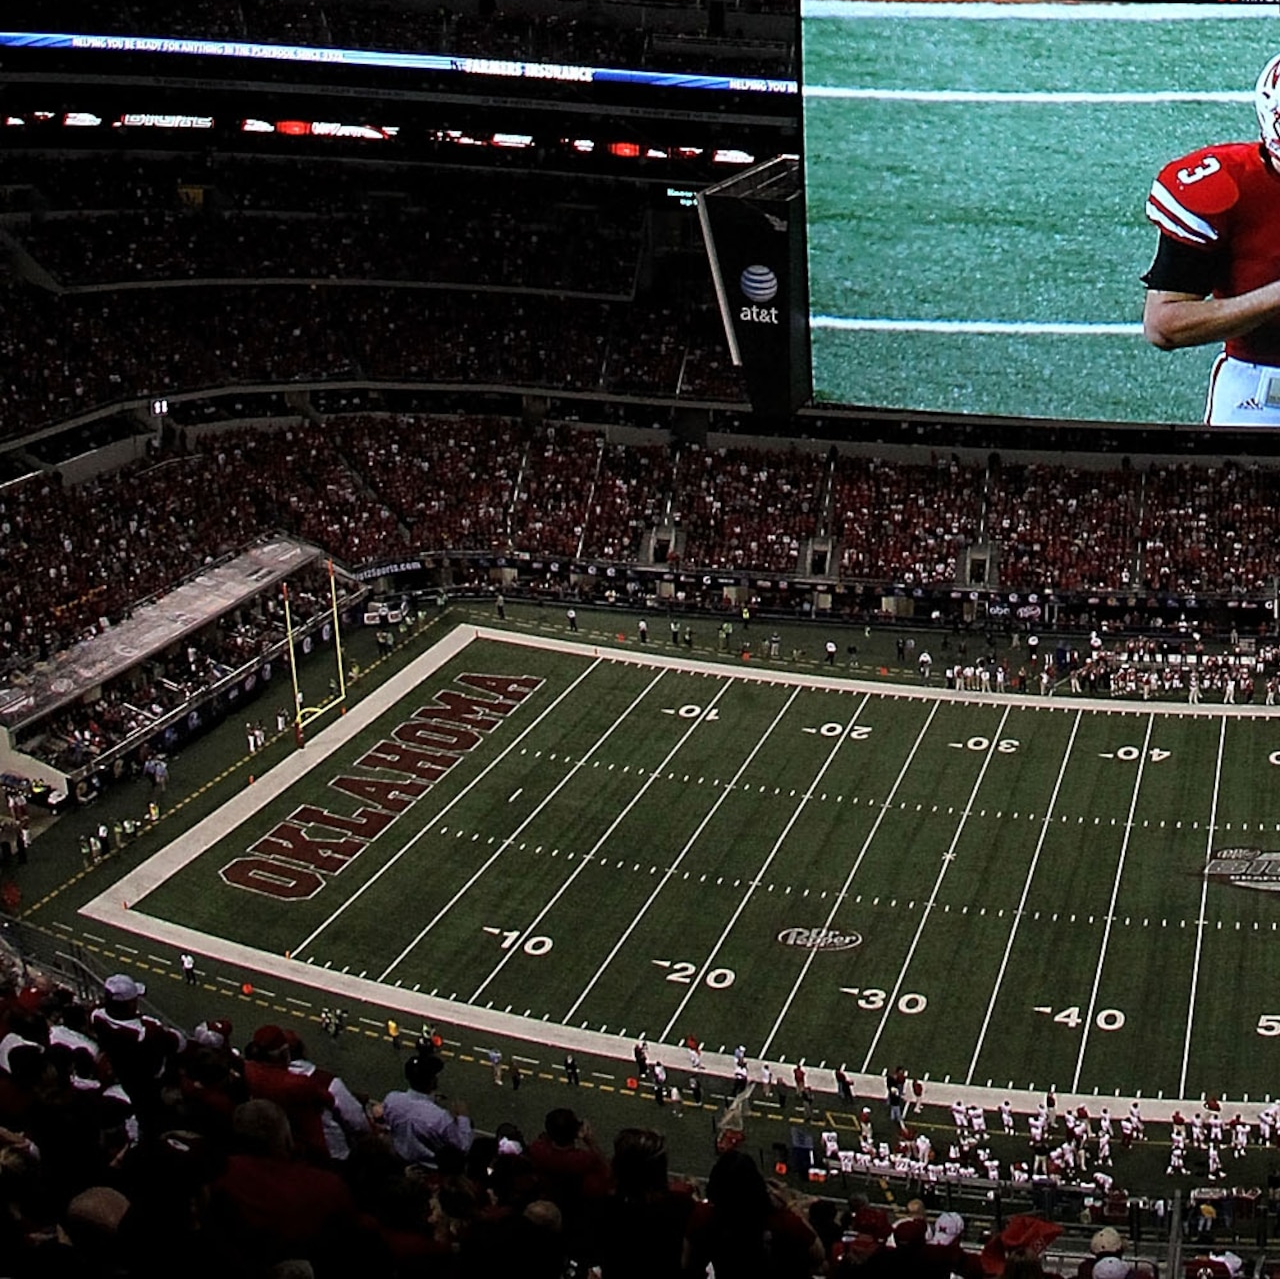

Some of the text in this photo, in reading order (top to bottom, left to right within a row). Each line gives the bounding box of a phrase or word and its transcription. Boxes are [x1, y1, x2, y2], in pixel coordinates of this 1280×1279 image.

[465, 59, 593, 82] FARMERS INSURANCE
[1177, 155, 1221, 185] 3
[740, 305, 779, 324] at&t
[678, 704, 720, 721] 10
[820, 722, 873, 740] 20
[966, 736, 1020, 753] 30
[1116, 745, 1171, 762] 40
[218, 672, 546, 901] OKLAHOMA
[501, 930, 554, 956] 10
[666, 961, 735, 989] 20
[858, 988, 928, 1014] 30
[1053, 1006, 1125, 1031] 40
